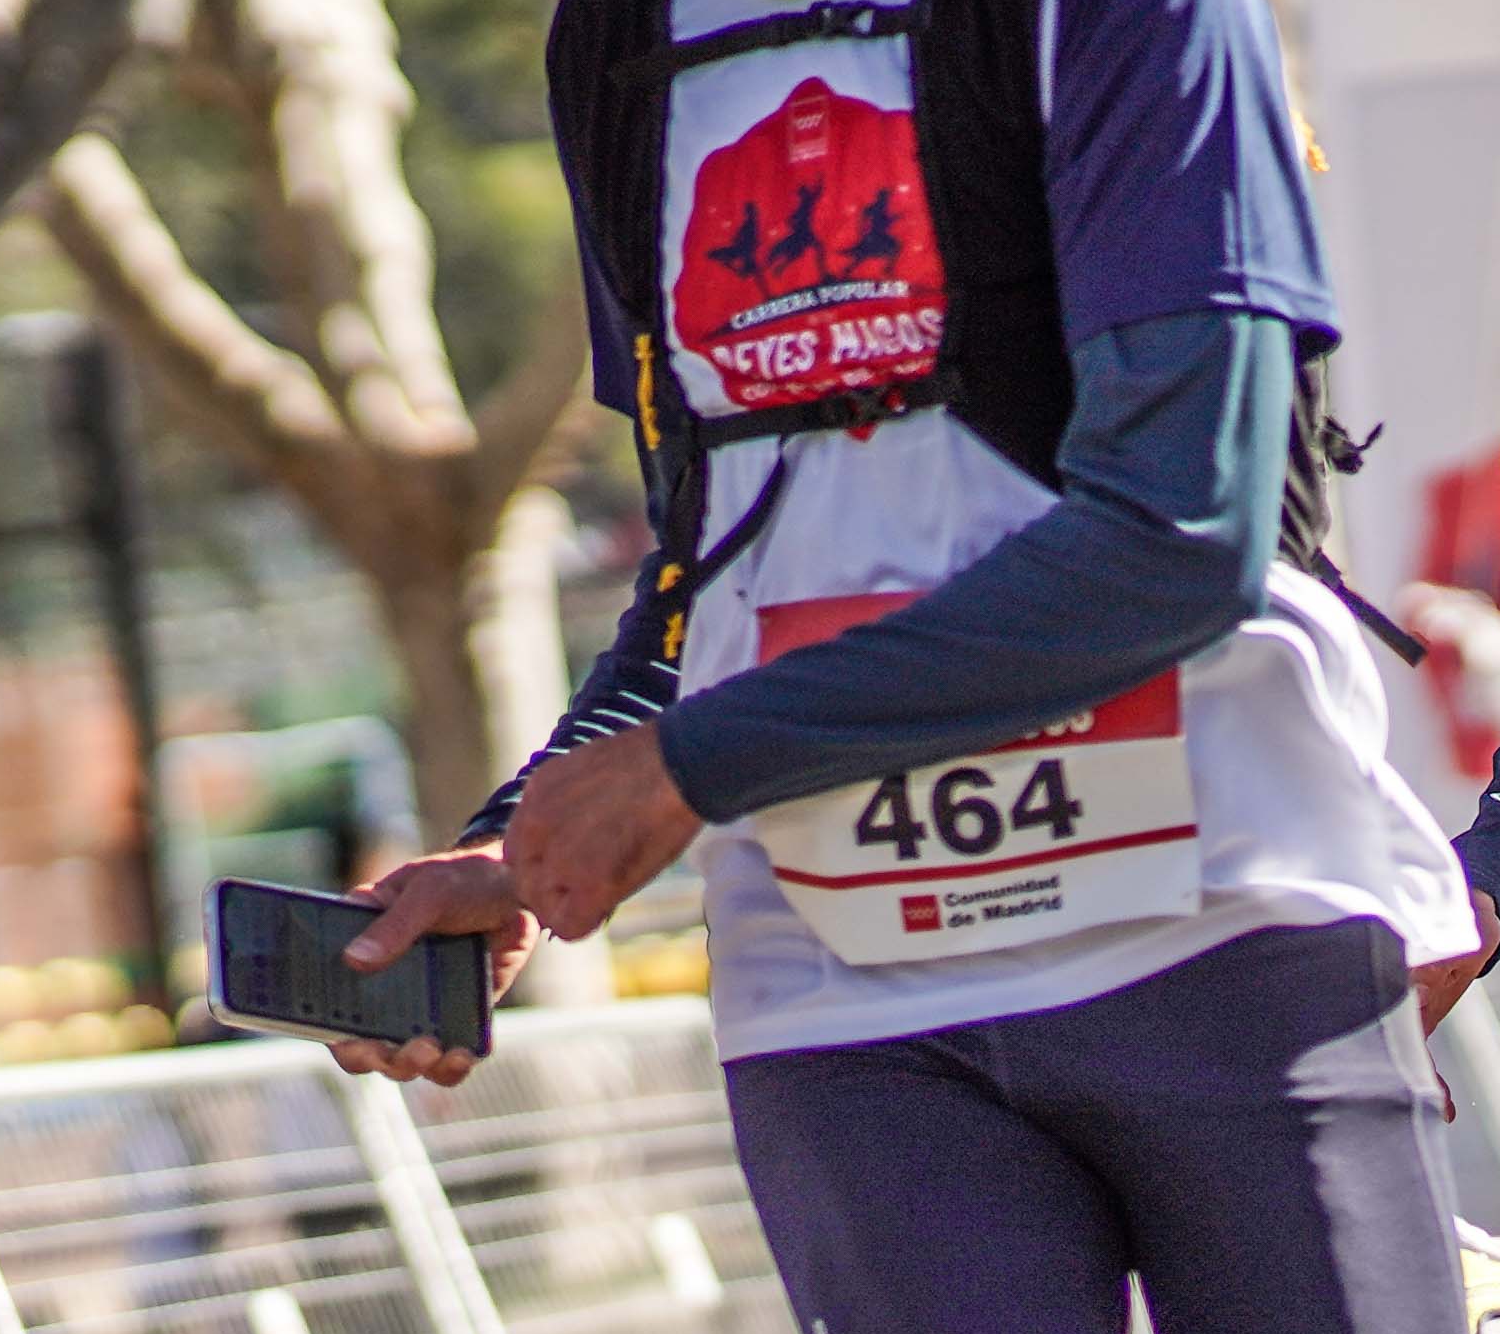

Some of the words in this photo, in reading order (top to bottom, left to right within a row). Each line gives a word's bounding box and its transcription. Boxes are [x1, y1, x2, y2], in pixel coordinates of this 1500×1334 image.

[854, 757, 1084, 861] 464
[944, 874, 1060, 907] Comunidad
[947, 912, 976, 928] de
[982, 894, 1063, 922] Madrid
